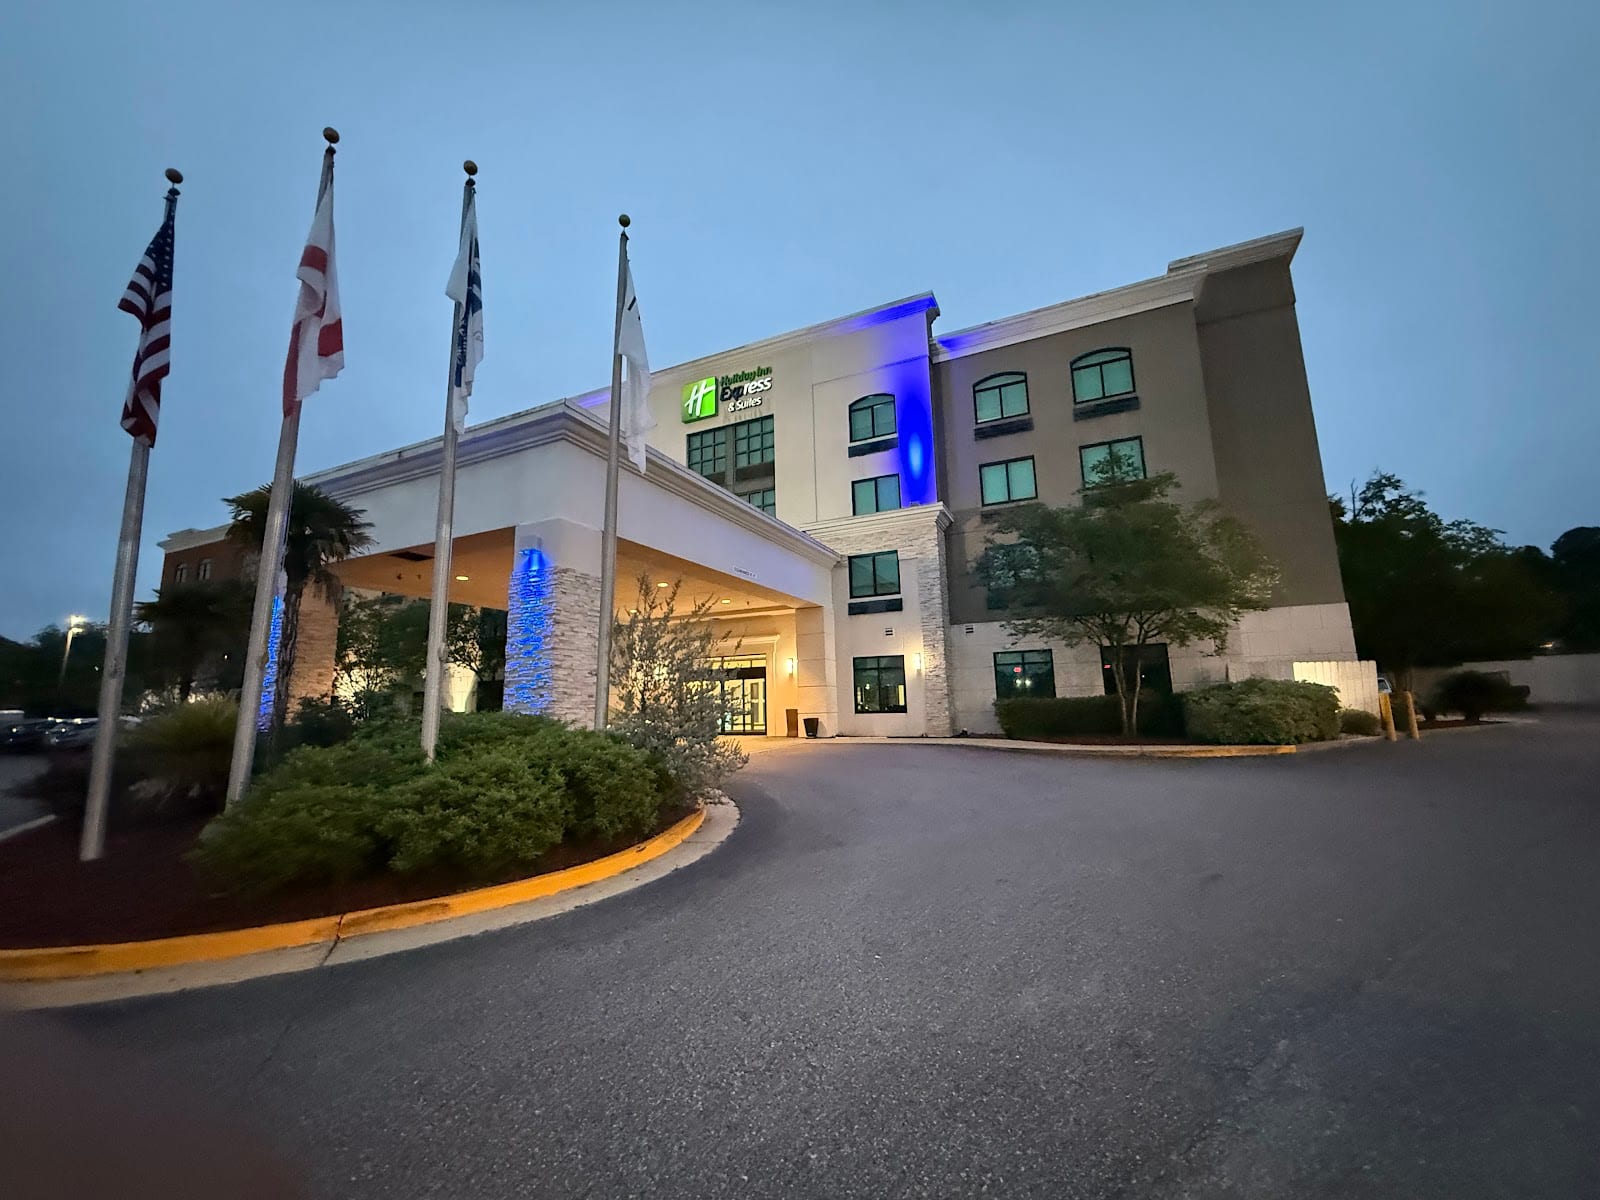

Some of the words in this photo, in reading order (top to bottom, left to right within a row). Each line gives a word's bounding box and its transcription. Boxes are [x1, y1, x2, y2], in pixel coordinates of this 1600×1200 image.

[720, 371, 756, 388] Holiday
[756, 366, 773, 378] Inn
[719, 377, 773, 402] Express
[727, 404, 736, 413] &
[735, 397, 763, 412] Suites
